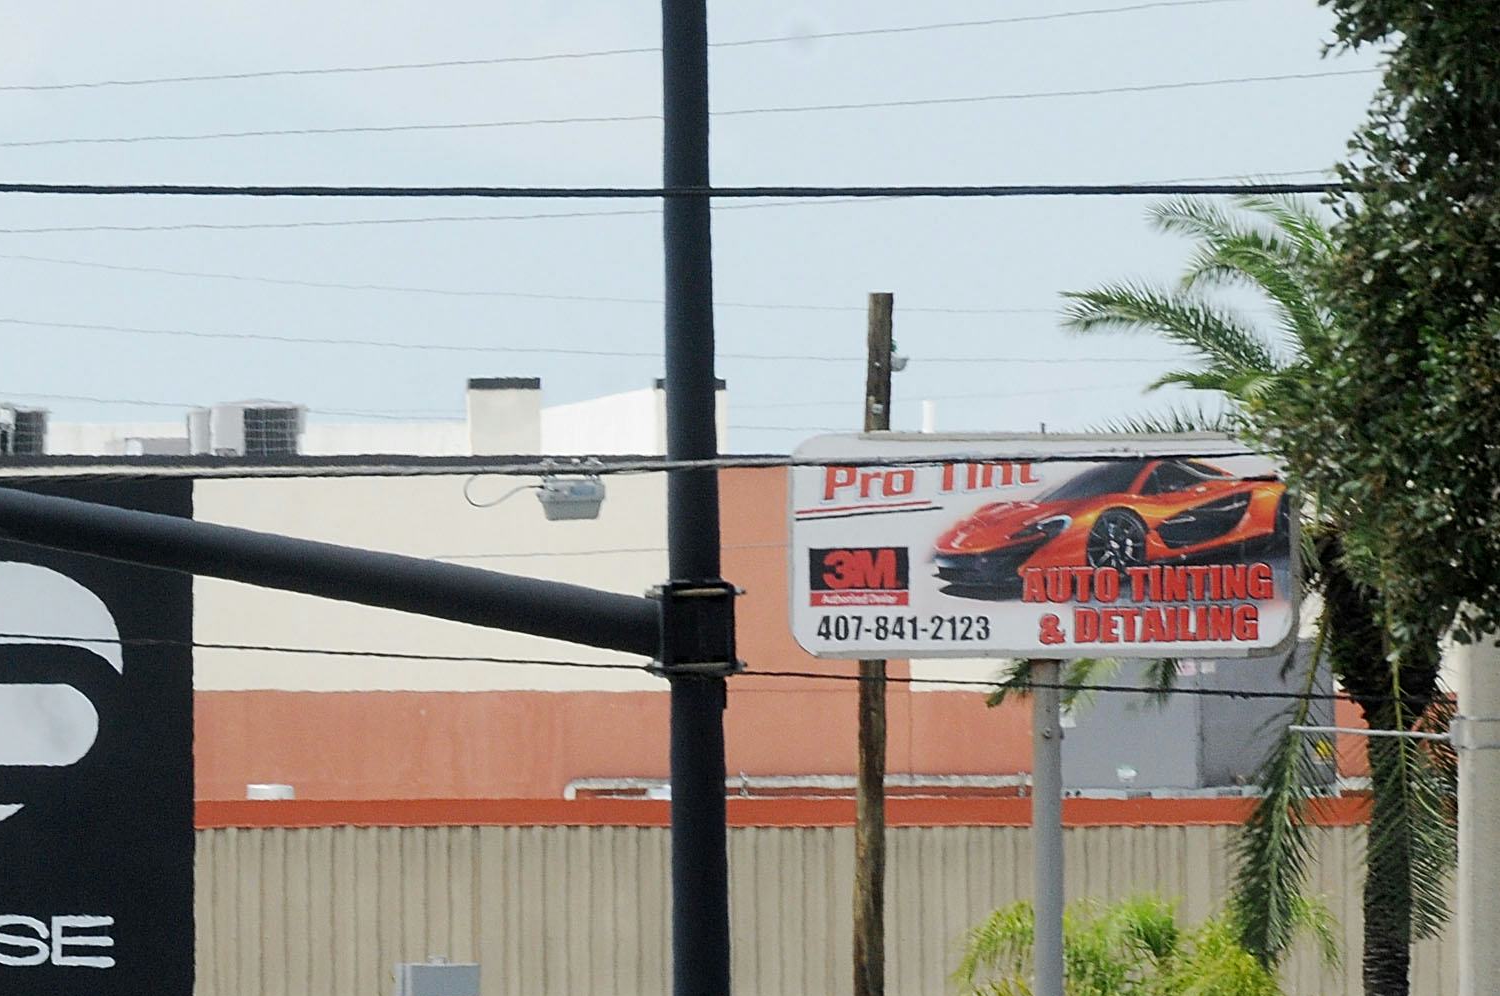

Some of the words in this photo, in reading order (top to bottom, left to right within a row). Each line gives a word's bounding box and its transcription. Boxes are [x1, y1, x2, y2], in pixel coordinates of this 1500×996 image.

[823, 464, 915, 501] Pro
[822, 548, 901, 590] 3M
[1021, 565, 1121, 603] AUTO
[1126, 562, 1275, 601] TINTING
[816, 615, 991, 641] 407-841-2123
[1038, 612, 1066, 645] &
[1074, 603, 1259, 644] DETAILING
